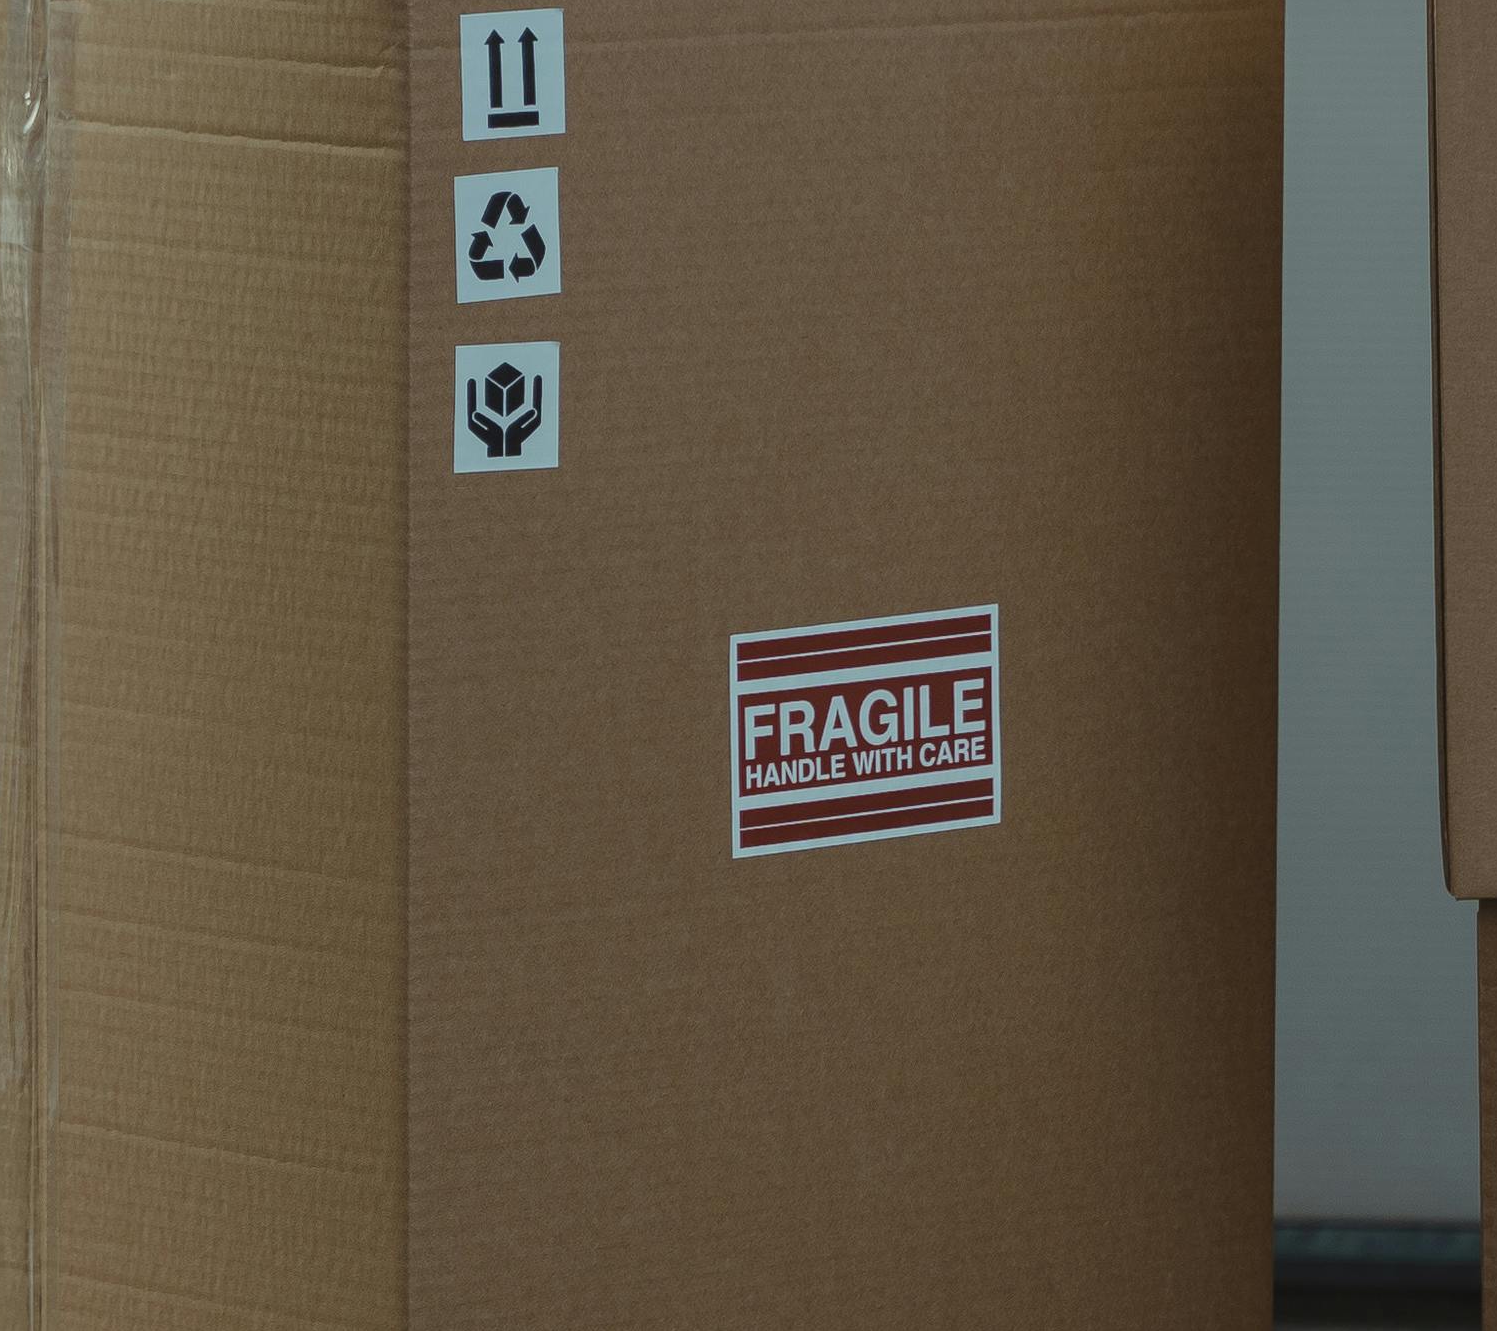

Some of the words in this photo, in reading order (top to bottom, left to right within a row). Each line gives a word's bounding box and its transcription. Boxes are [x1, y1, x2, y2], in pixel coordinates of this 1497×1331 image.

[744, 677, 986, 760] FRAGILE
[745, 753, 846, 790] HANDLE
[852, 744, 914, 776] WITH
[919, 736, 986, 767] CARE
